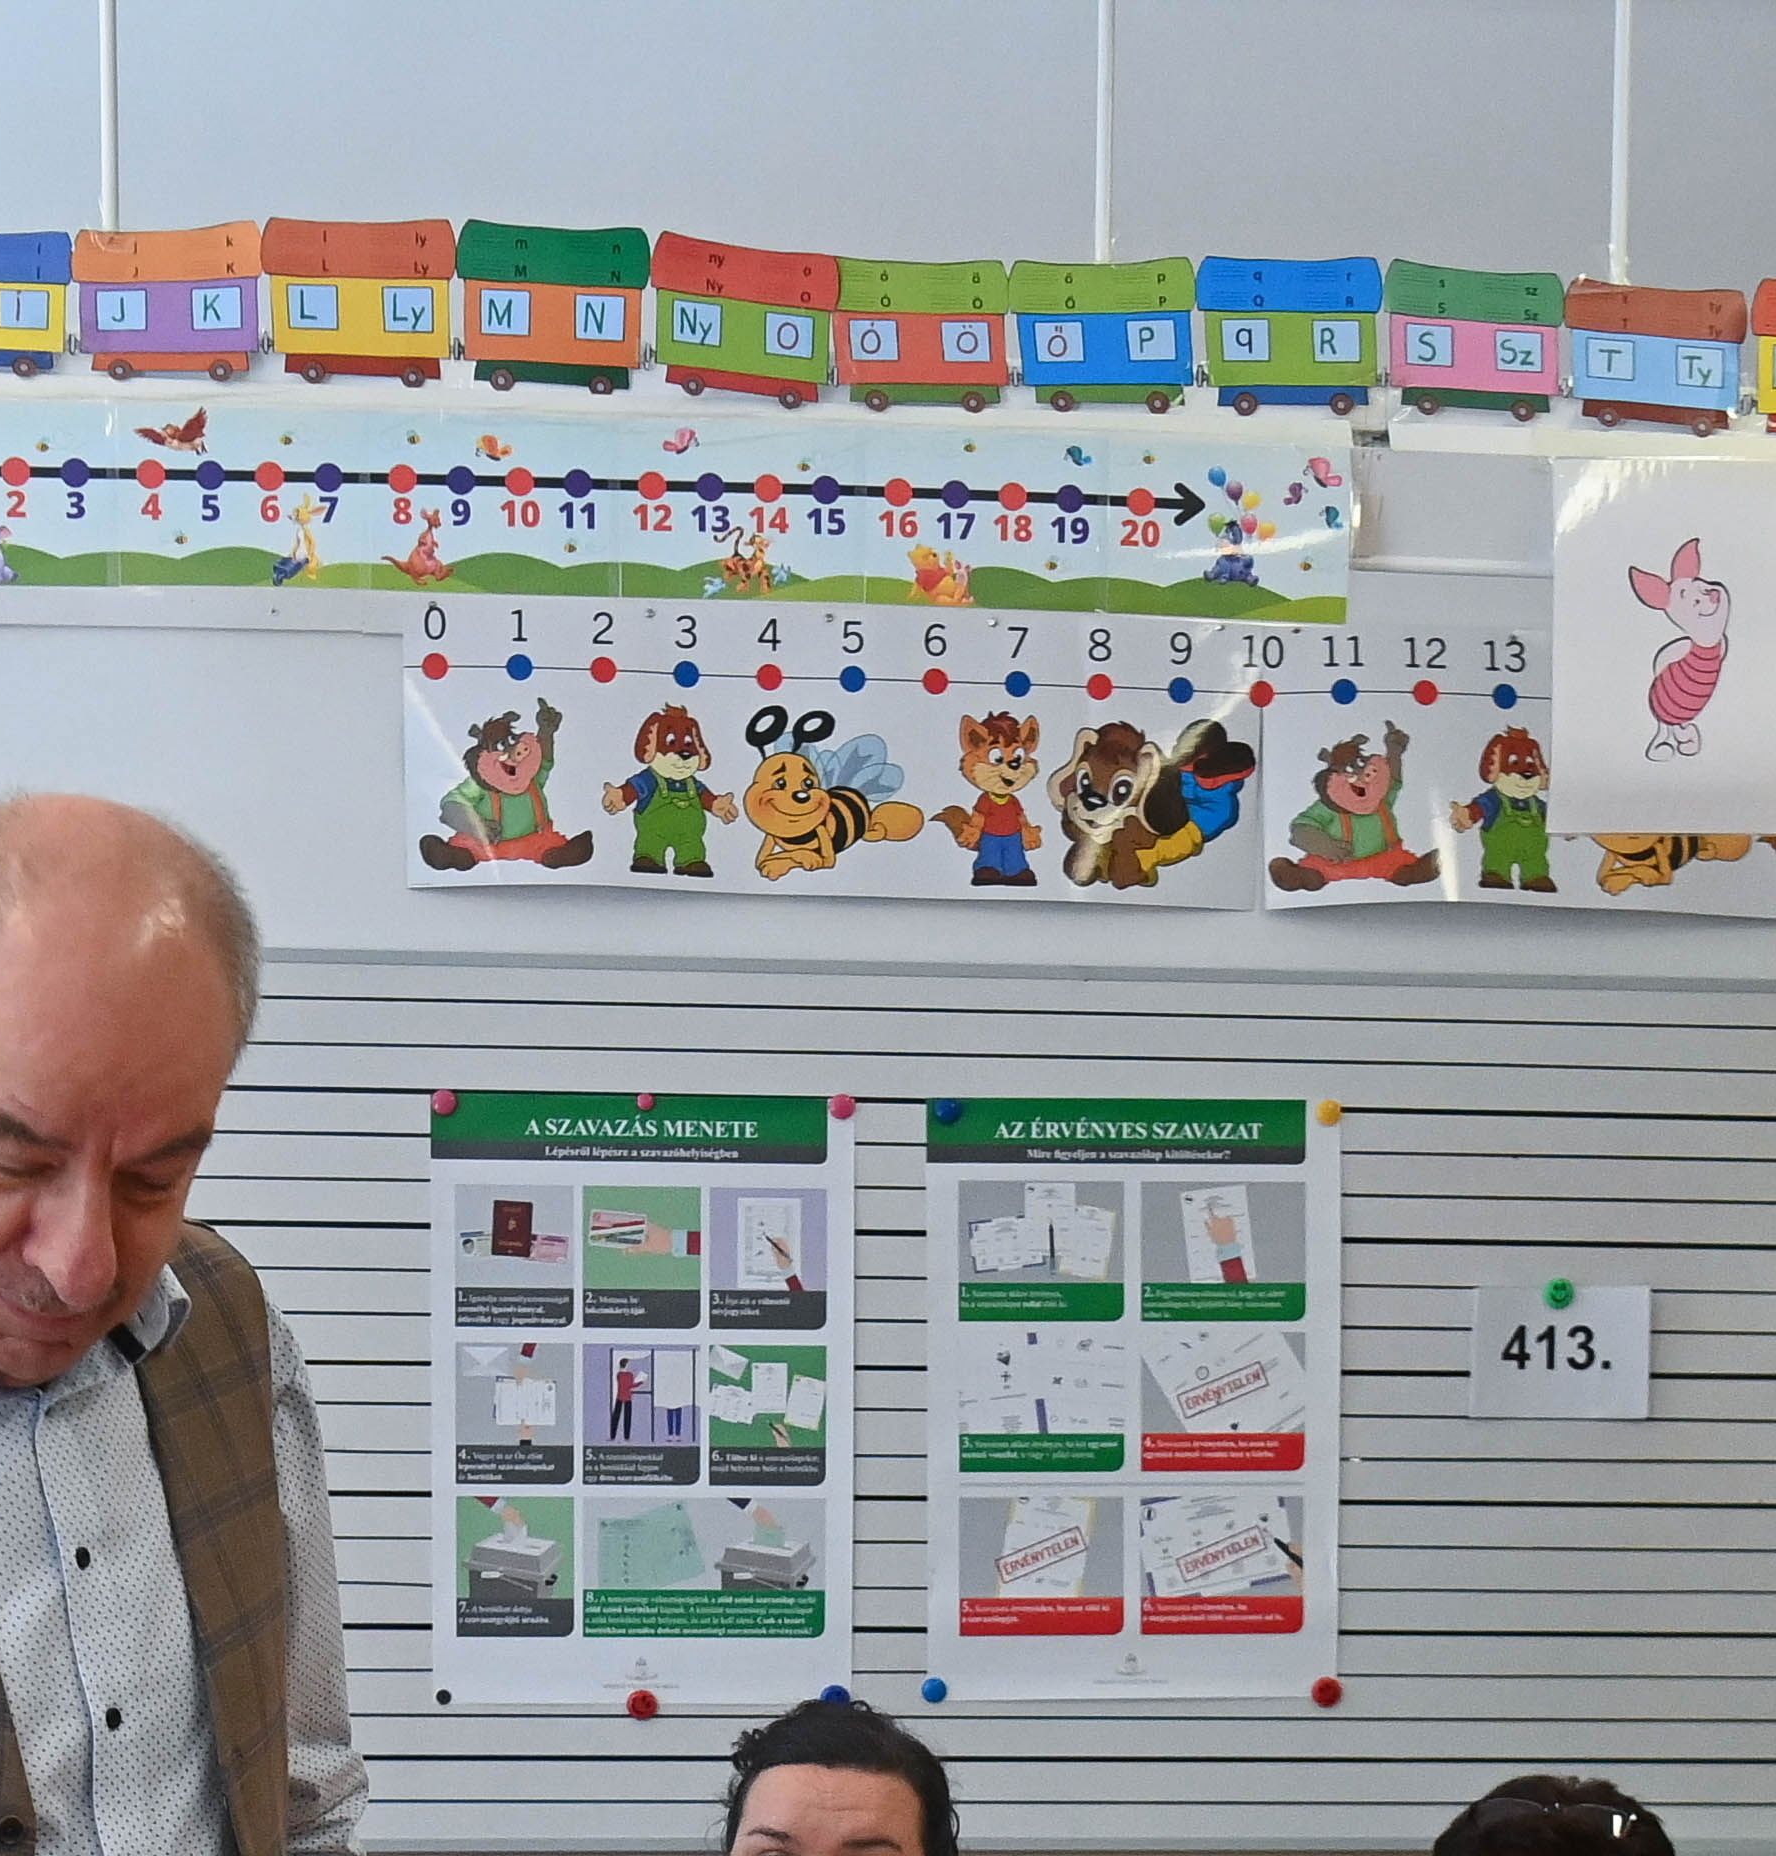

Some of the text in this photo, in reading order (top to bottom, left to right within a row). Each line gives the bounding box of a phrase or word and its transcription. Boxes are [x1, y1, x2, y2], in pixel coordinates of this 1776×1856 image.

[112, 298, 125, 322] J
[203, 295, 220, 321] K
[300, 290, 317, 320] L
[392, 293, 425, 333] Ly
[488, 299, 512, 328] M
[584, 302, 605, 334] N
[678, 306, 713, 345] Ny
[777, 322, 799, 350] O
[1139, 327, 1154, 352] P
[1320, 327, 1336, 354] R
[1418, 332, 1436, 362] S
[1500, 339, 1534, 366] Sz
[1599, 349, 1622, 372] T
[1681, 354, 1713, 388] Ty
[7, 491, 26, 517] 2
[67, 492, 85, 519] 3
[141, 494, 162, 520] 4
[202, 495, 220, 521] 5
[261, 495, 280, 522] 6
[319, 497, 338, 523] 7
[393, 498, 412, 524] 8
[451, 499, 470, 526] 9
[501, 500, 540, 527] 10
[559, 502, 595, 529] 11
[633, 504, 672, 531] 12
[692, 506, 730, 532] 13
[750, 507, 789, 533] 14
[807, 508, 845, 535] 15
[879, 511, 918, 538] 16
[937, 513, 975, 539] 17
[994, 515, 1032, 542] 18
[1051, 517, 1089, 544] 19
[1121, 520, 1160, 547] 20
[425, 608, 446, 640] 0
[512, 610, 527, 641] 1
[593, 612, 613, 644] 2
[675, 616, 696, 649] 3
[758, 619, 781, 651] 4
[843, 621, 863, 653] 5
[925, 624, 946, 656] 6
[1008, 627, 1028, 658] 7
[1089, 629, 1111, 662] 8
[1171, 632, 1192, 665] 9
[1243, 635, 1283, 668] 10
[1323, 636, 1363, 667] 11
[1405, 637, 1446, 669] 12
[1484, 640, 1525, 672] 13
[525, 1116, 759, 1138] A SZAVAZÁS MENETE
[994, 1117, 1263, 1140] AZ ÉRVÉNYES SZAVAZAT
[1501, 1325, 1611, 1370] 413.
